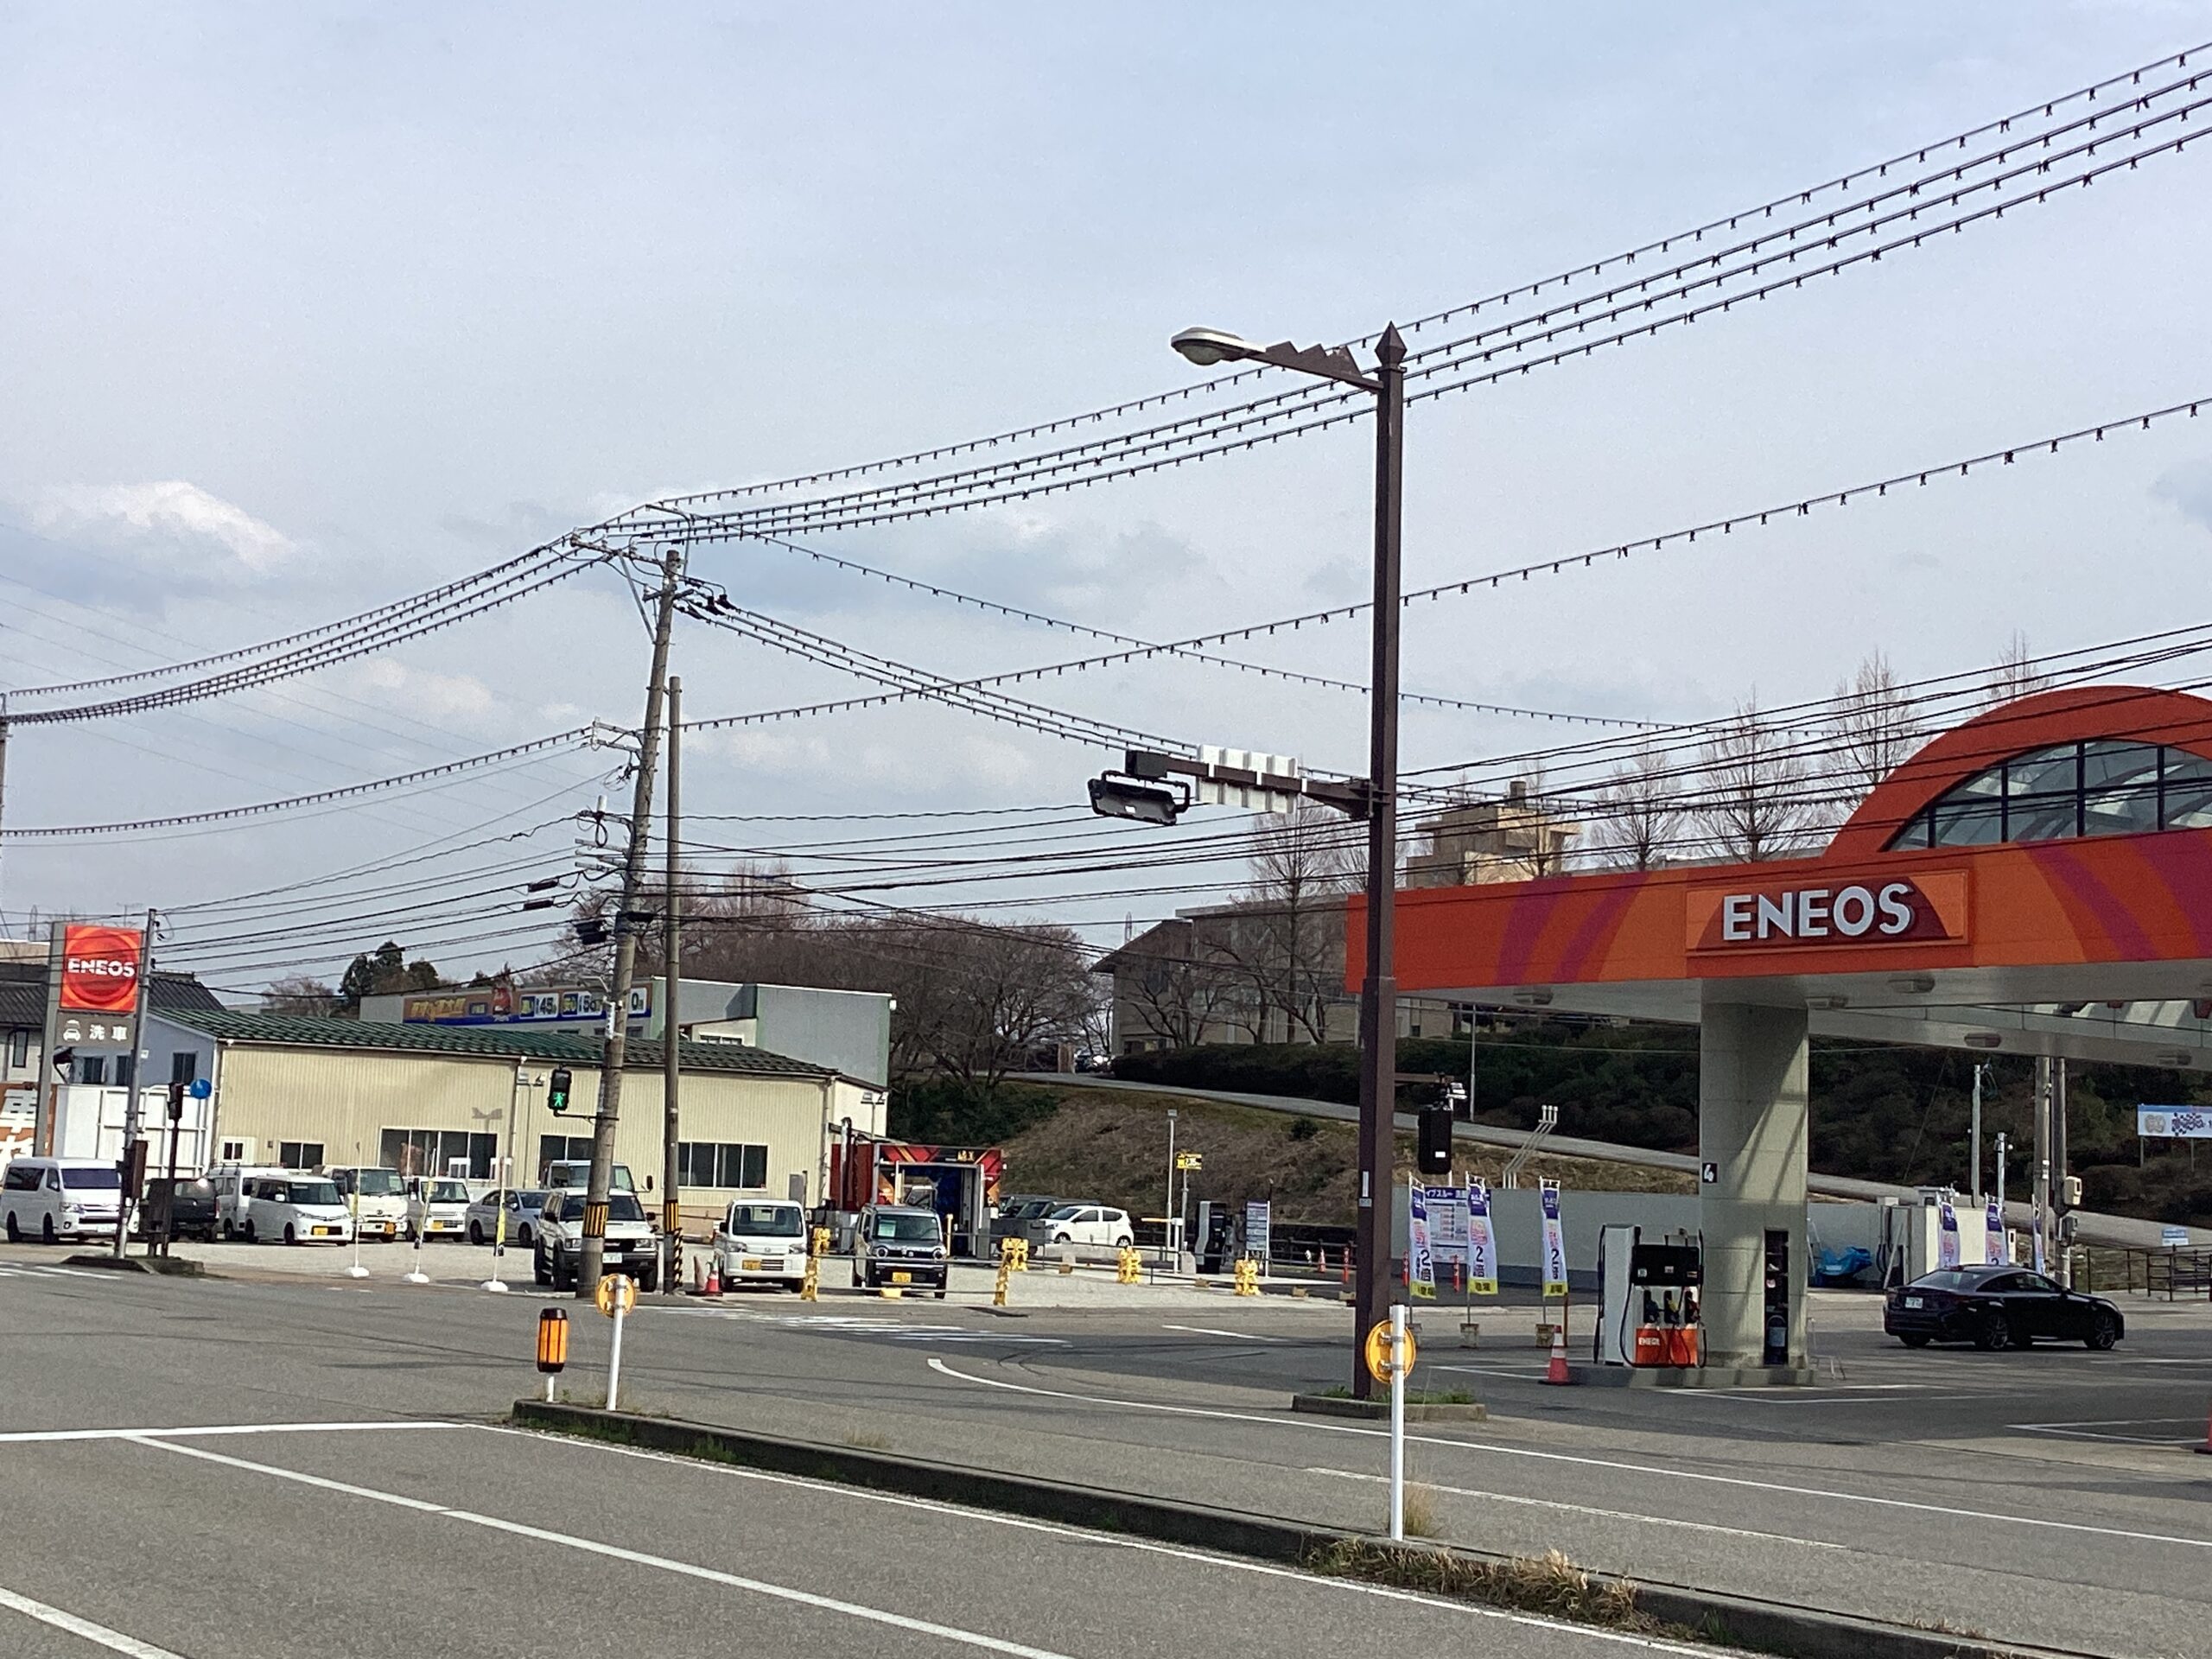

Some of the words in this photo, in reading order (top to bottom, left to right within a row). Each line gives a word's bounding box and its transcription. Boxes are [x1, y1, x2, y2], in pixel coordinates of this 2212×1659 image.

[1722, 882, 1914, 942] ENEOS
[67, 957, 136, 978] ENEOS
[89, 1024, 128, 1041] 洗車
[1704, 1164, 1714, 1182] 4
